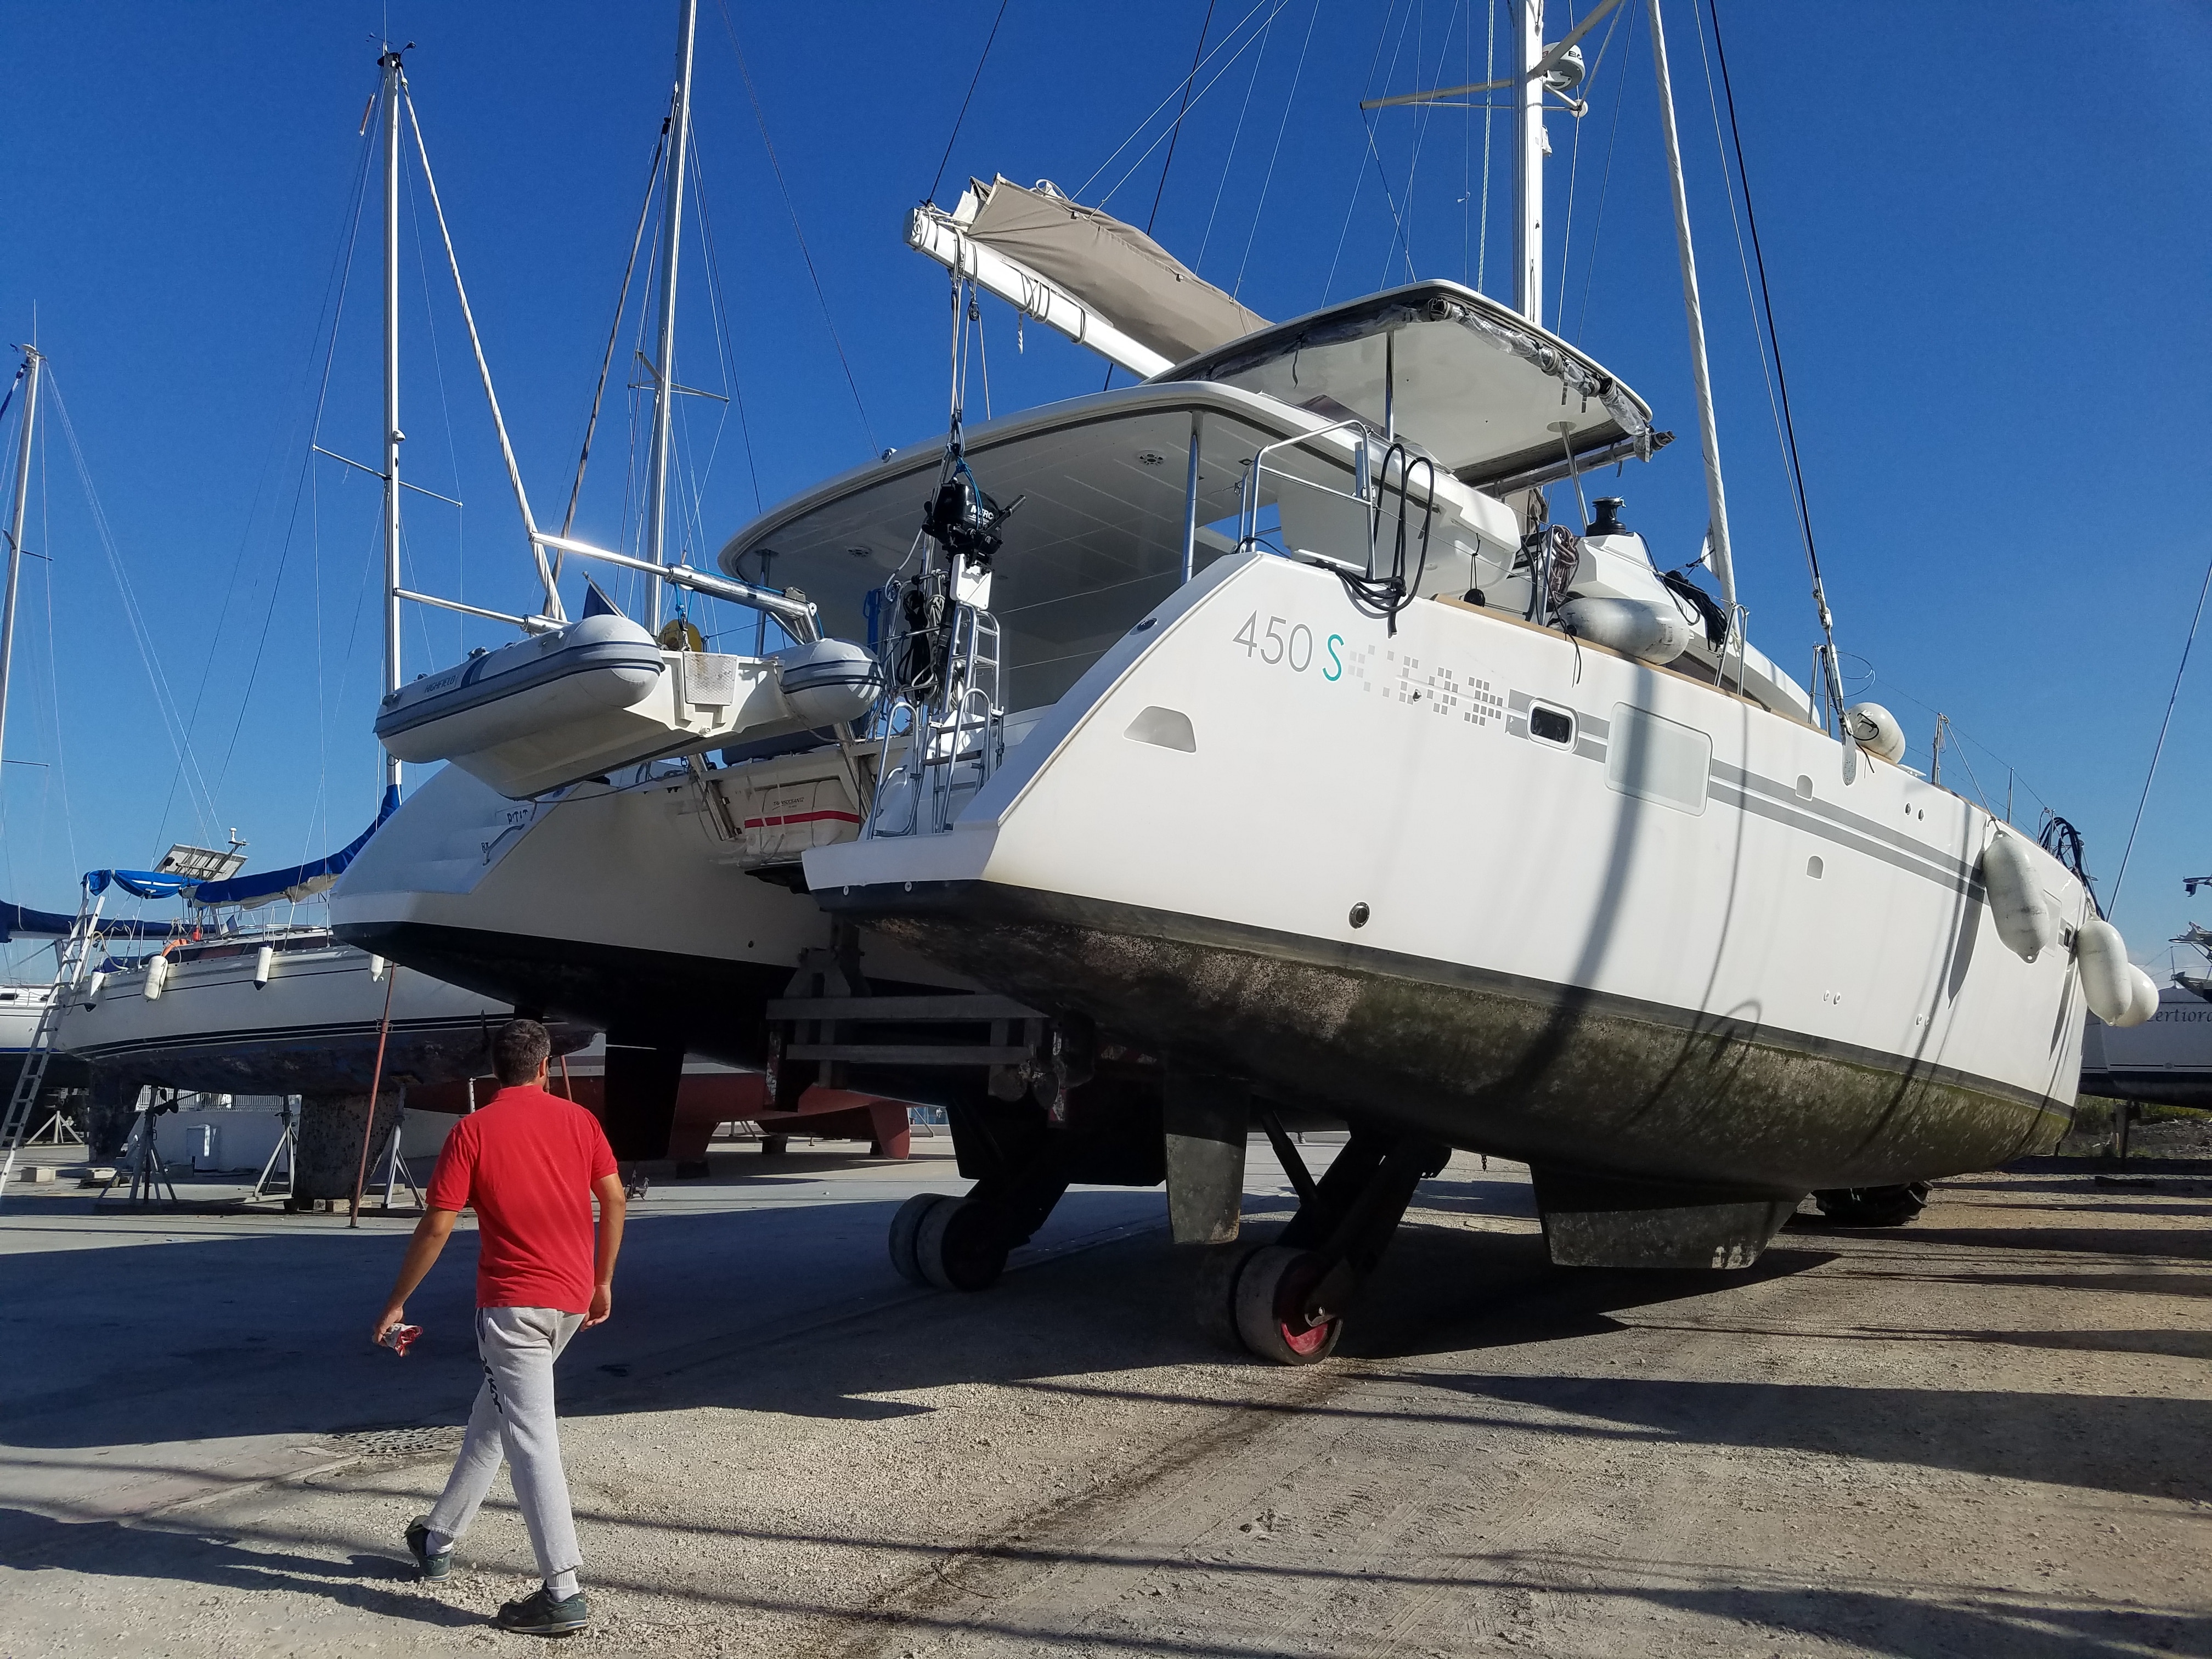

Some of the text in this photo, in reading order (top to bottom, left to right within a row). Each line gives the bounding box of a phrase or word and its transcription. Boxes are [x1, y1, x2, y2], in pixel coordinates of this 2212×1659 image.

[1232, 610, 1344, 681] 450 S
[424, 675, 456, 694] HIGHFIELD
[2147, 1008, 2212, 1022] ertior
